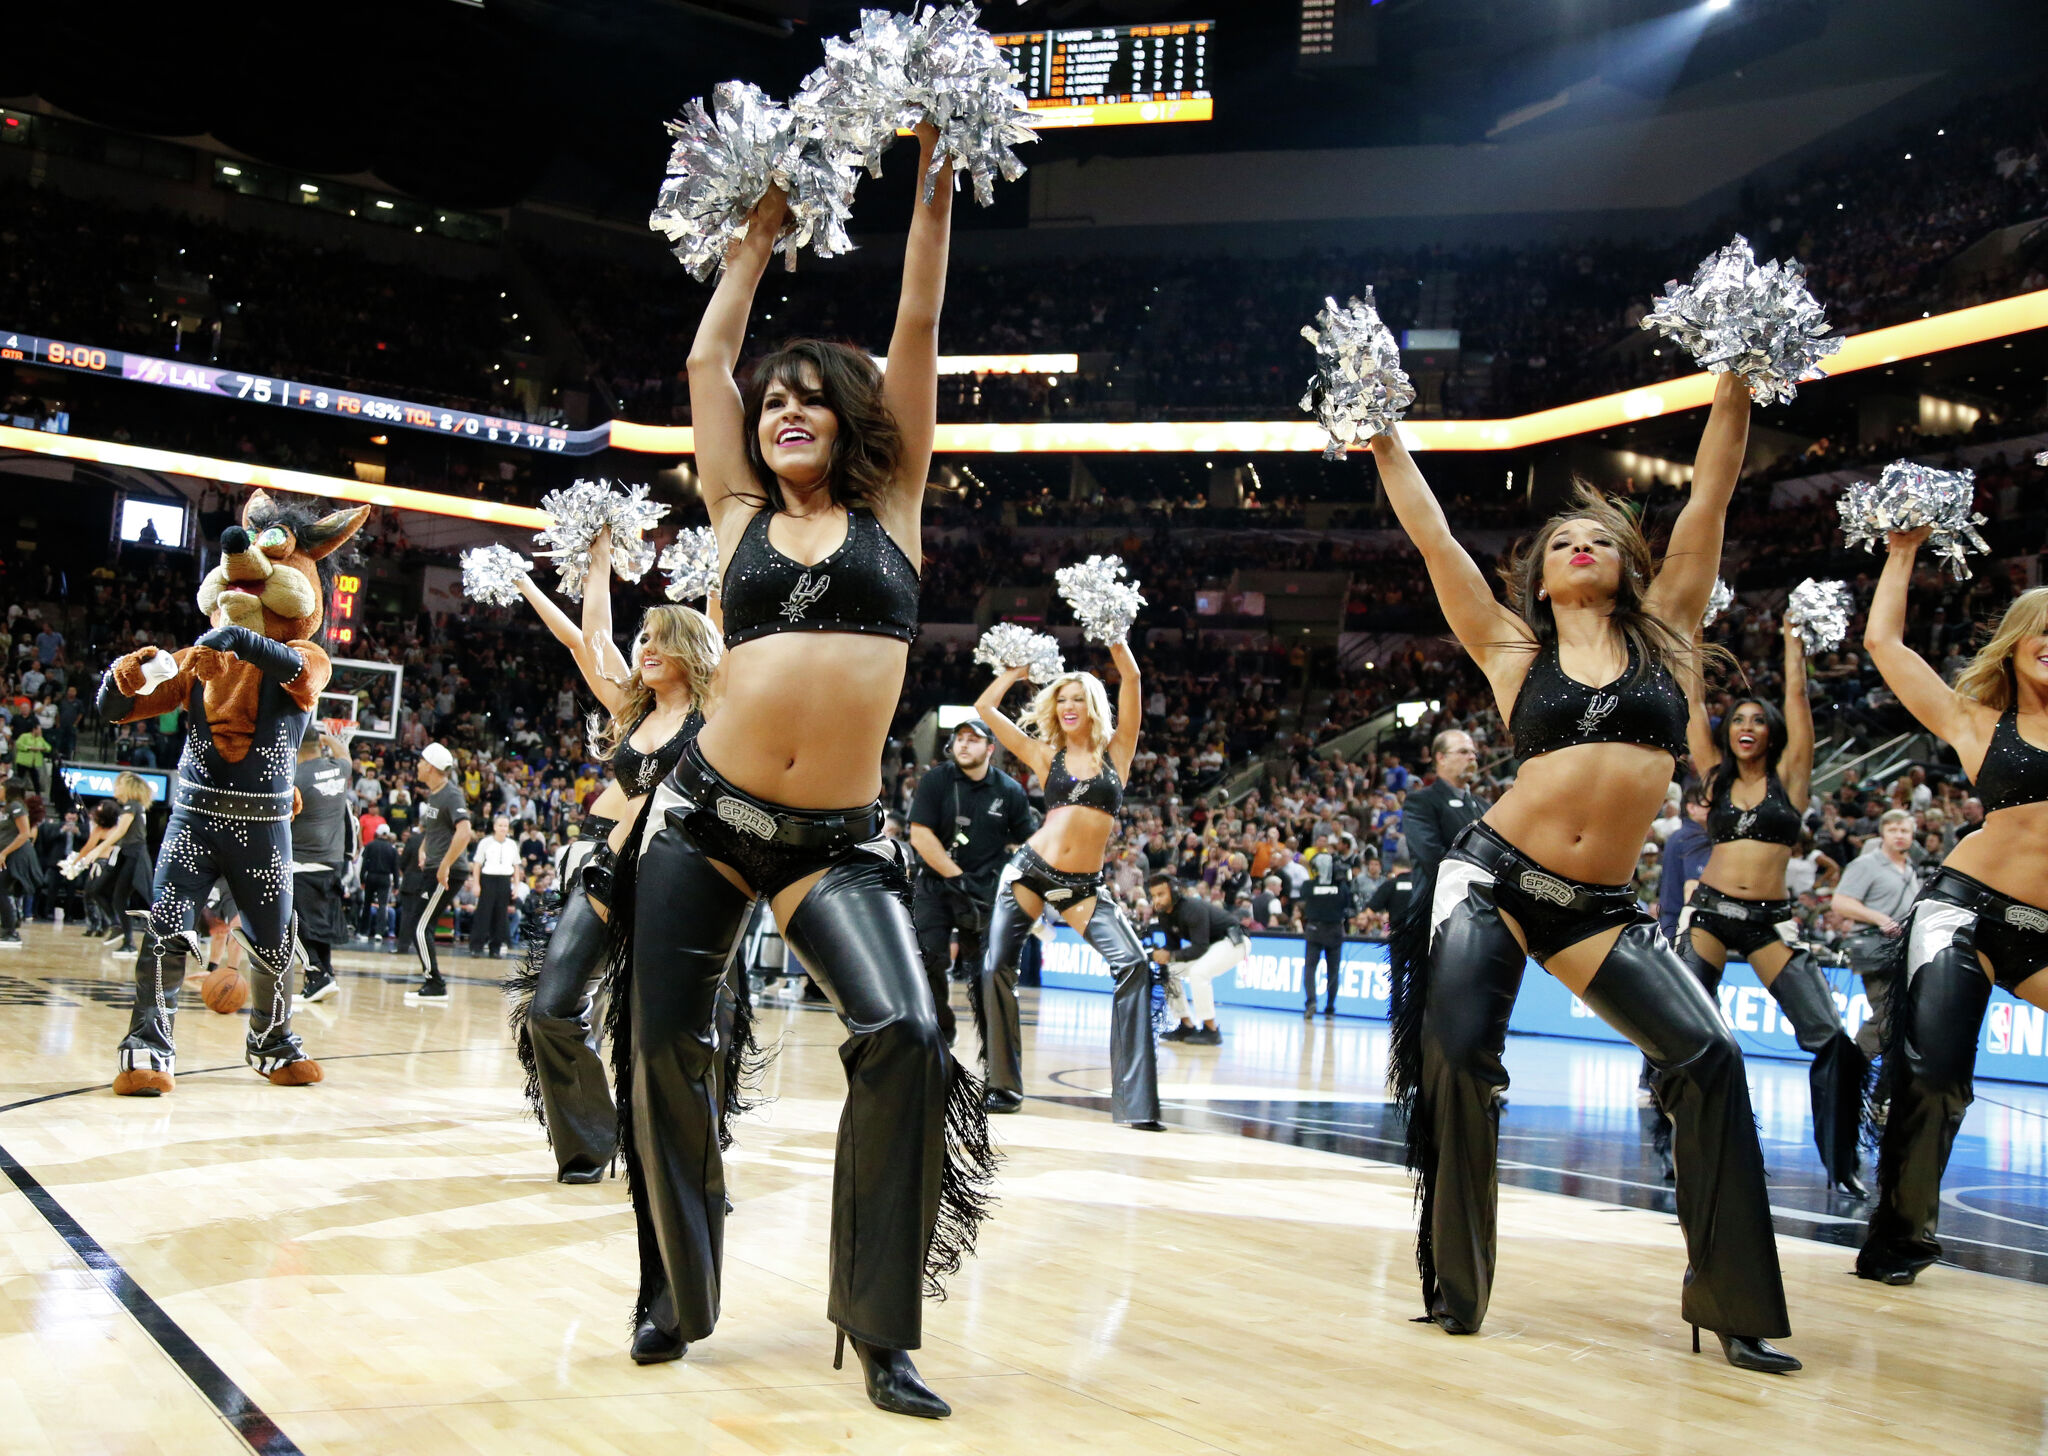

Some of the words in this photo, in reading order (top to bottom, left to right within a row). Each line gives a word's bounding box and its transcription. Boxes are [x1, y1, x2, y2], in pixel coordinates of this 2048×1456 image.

[7, 335, 18, 348] 4
[48, 343, 107, 370] 9:00
[169, 366, 212, 390] LAL
[236, 375, 272, 403] 75
[299, 389, 310, 405] F
[315, 391, 329, 409] 3
[337, 396, 361, 414] FG
[362, 401, 402, 422] 43%
[404, 407, 435, 428] TOL
[488, 427, 499, 441] 5
[510, 431, 519, 444] 7
[527, 434, 544, 448] 17
[723, 806, 769, 832] SPURS
[1526, 879, 1567, 899] SPURS
[2011, 911, 2046, 928] SPURS
